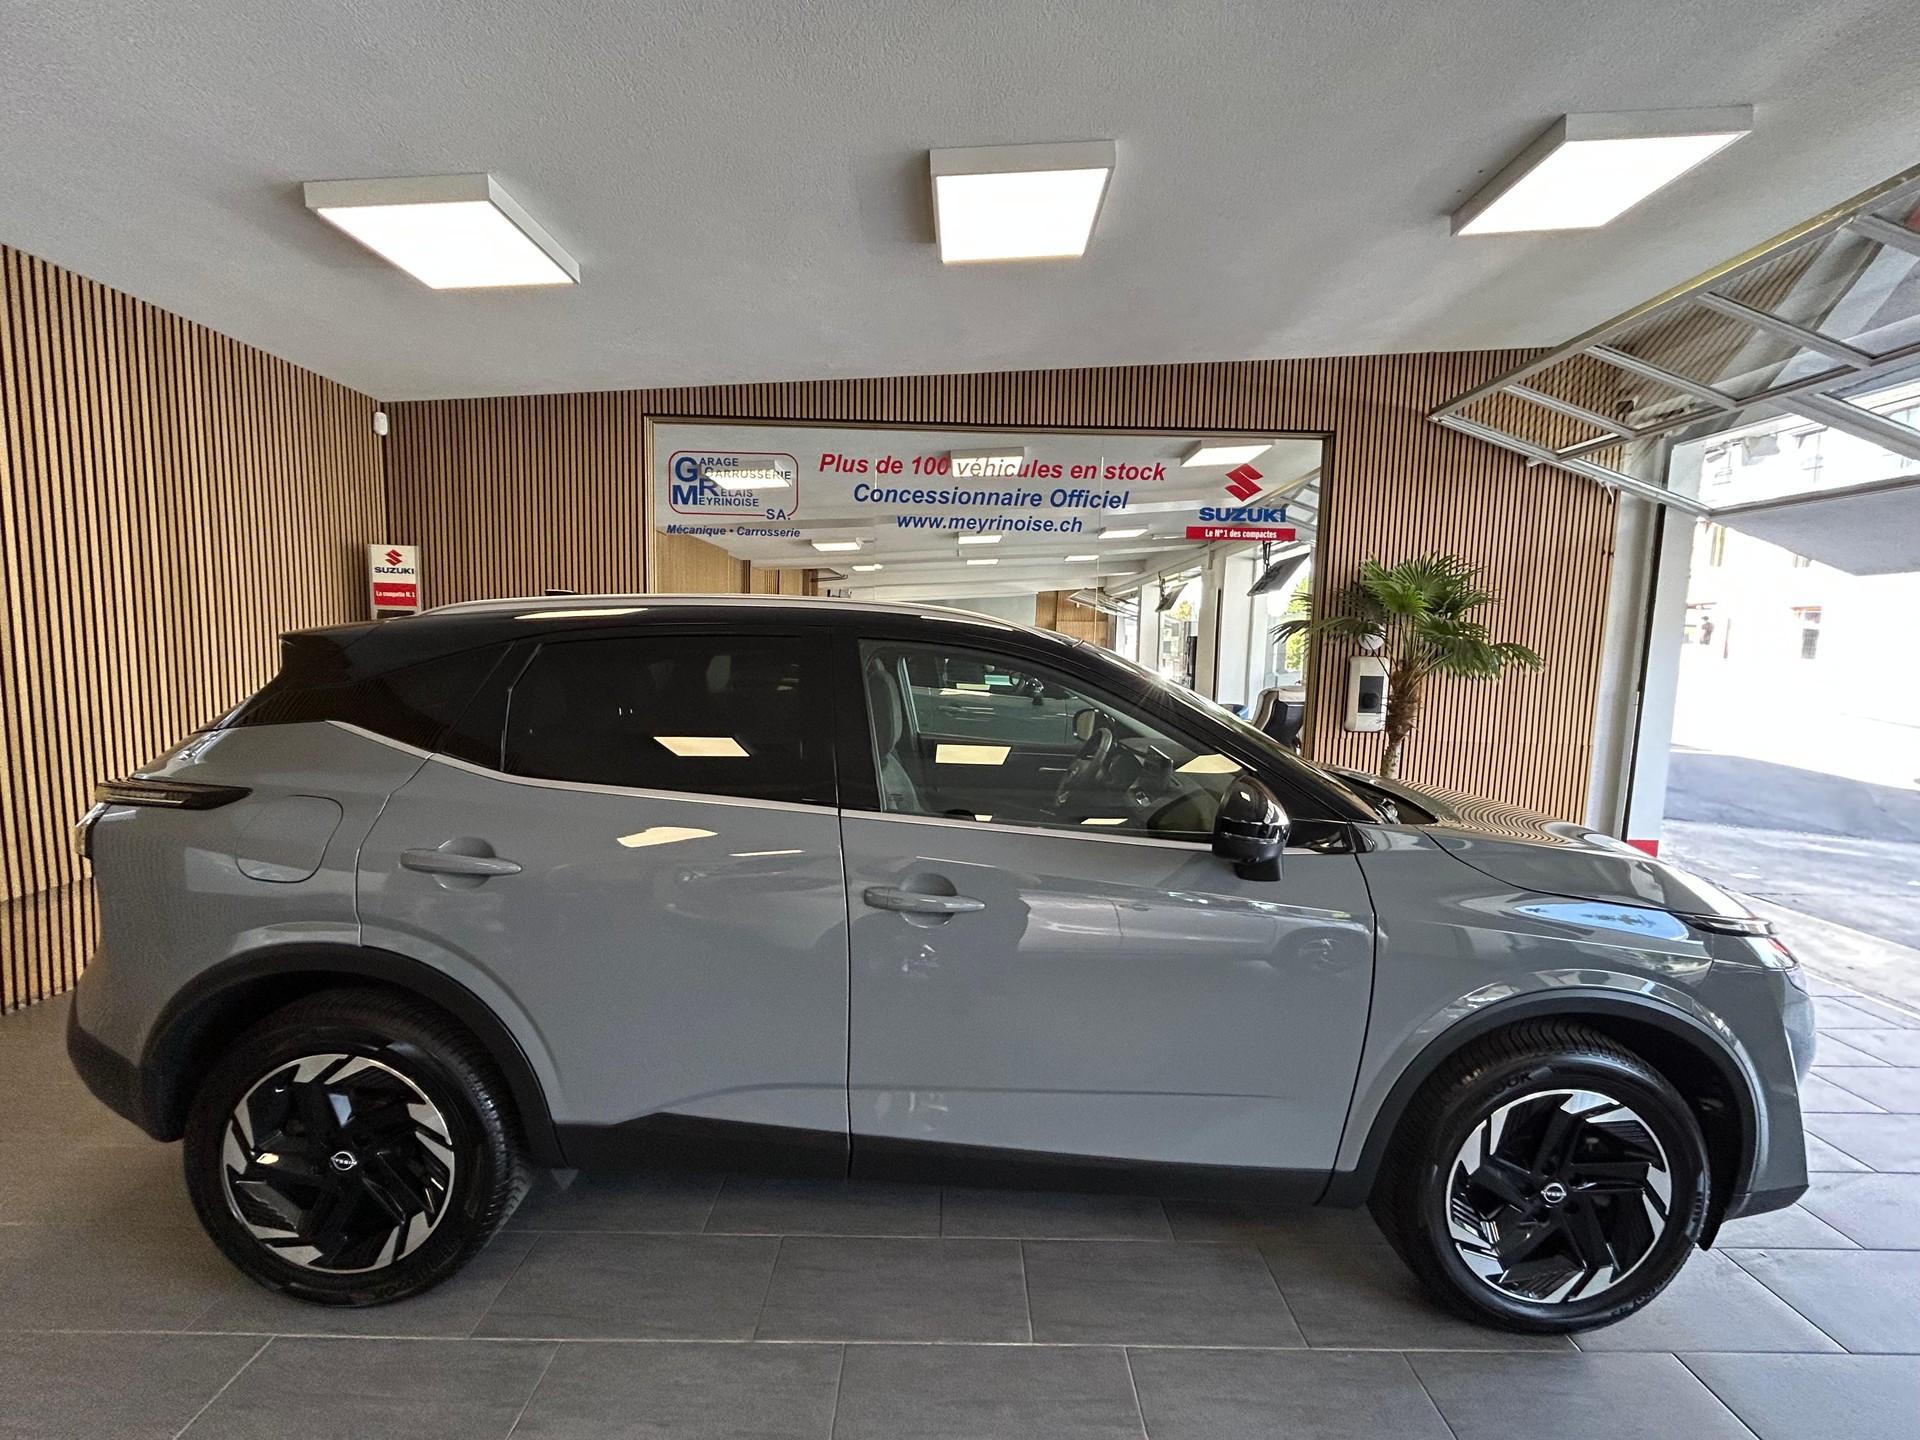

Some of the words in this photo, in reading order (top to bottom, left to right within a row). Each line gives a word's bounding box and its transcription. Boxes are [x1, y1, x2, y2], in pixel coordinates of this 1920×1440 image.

[819, 453, 869, 473] Plus
[876, 456, 903, 474] de
[912, 456, 950, 476] 100
[956, 457, 1063, 479] véhicules
[1070, 463, 1097, 479] en
[1103, 462, 1167, 481] stock
[854, 483, 1043, 507] Concessionnaire
[1050, 488, 1130, 509] Officiel
[1199, 507, 1287, 523] SUZUKI
[666, 524, 727, 537] Mécanique
[736, 526, 801, 538] Carrosserie
[897, 515, 1083, 534] www.meyrinoise.ch
[1205, 529, 1213, 537] Le
[1229, 529, 1242, 538] des
[1242, 530, 1278, 539] compactes
[374, 566, 415, 574] SUZUKI
